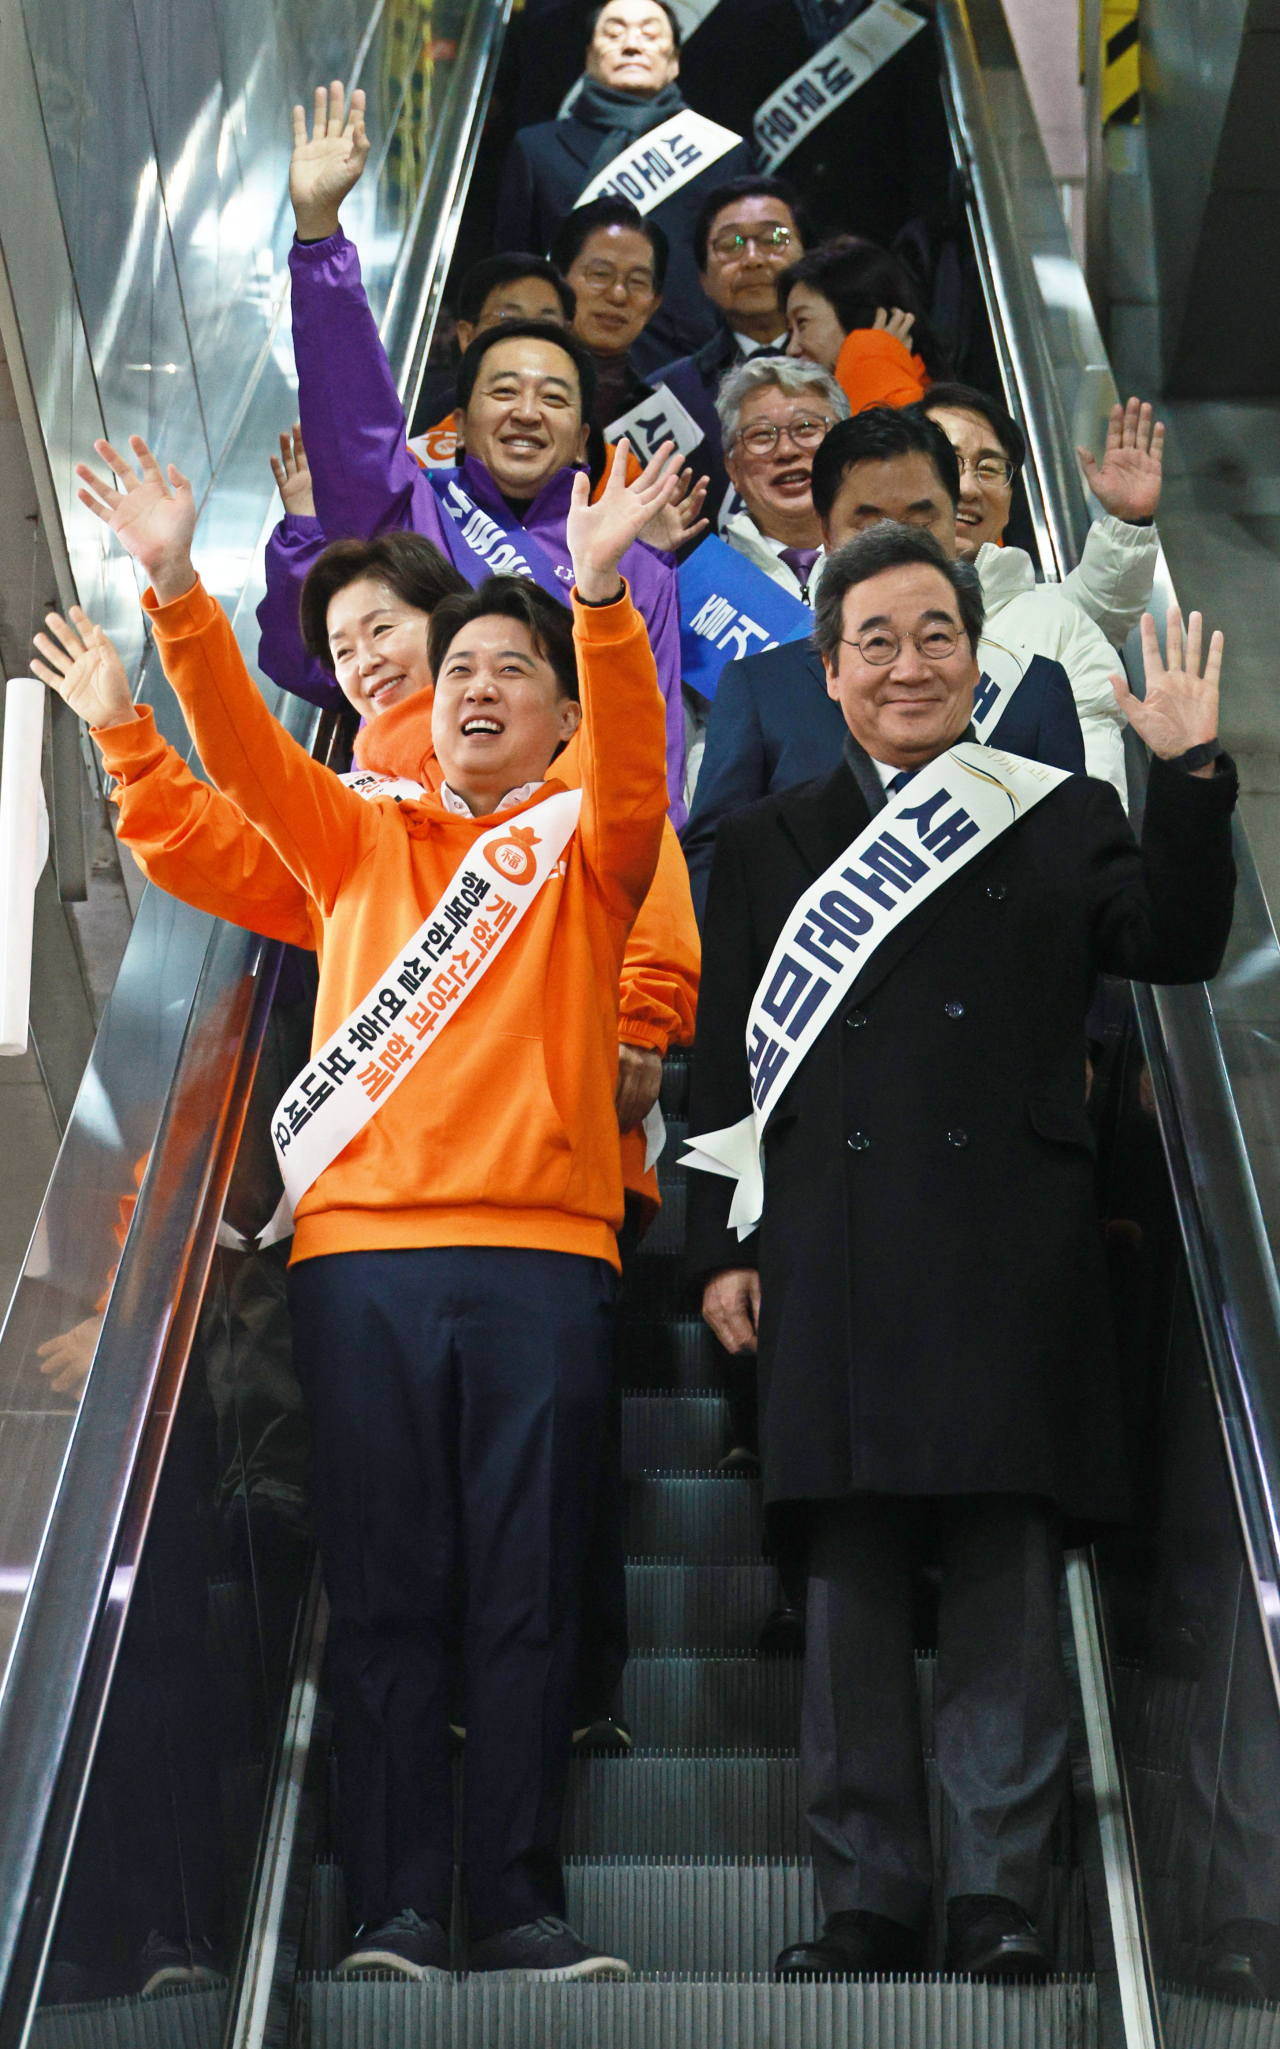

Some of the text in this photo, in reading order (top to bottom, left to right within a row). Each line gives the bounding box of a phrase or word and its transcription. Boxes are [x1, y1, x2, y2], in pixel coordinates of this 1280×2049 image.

[441, 480, 536, 584] 새로운
[689, 593, 779, 661] 즐거
[501, 847, 524, 870] 福
[272, 871, 491, 1157] 행복한 설 연휴 보내세요
[356, 894, 518, 1103] 개혁신당과 함께
[748, 787, 981, 1110] 새로운미래
